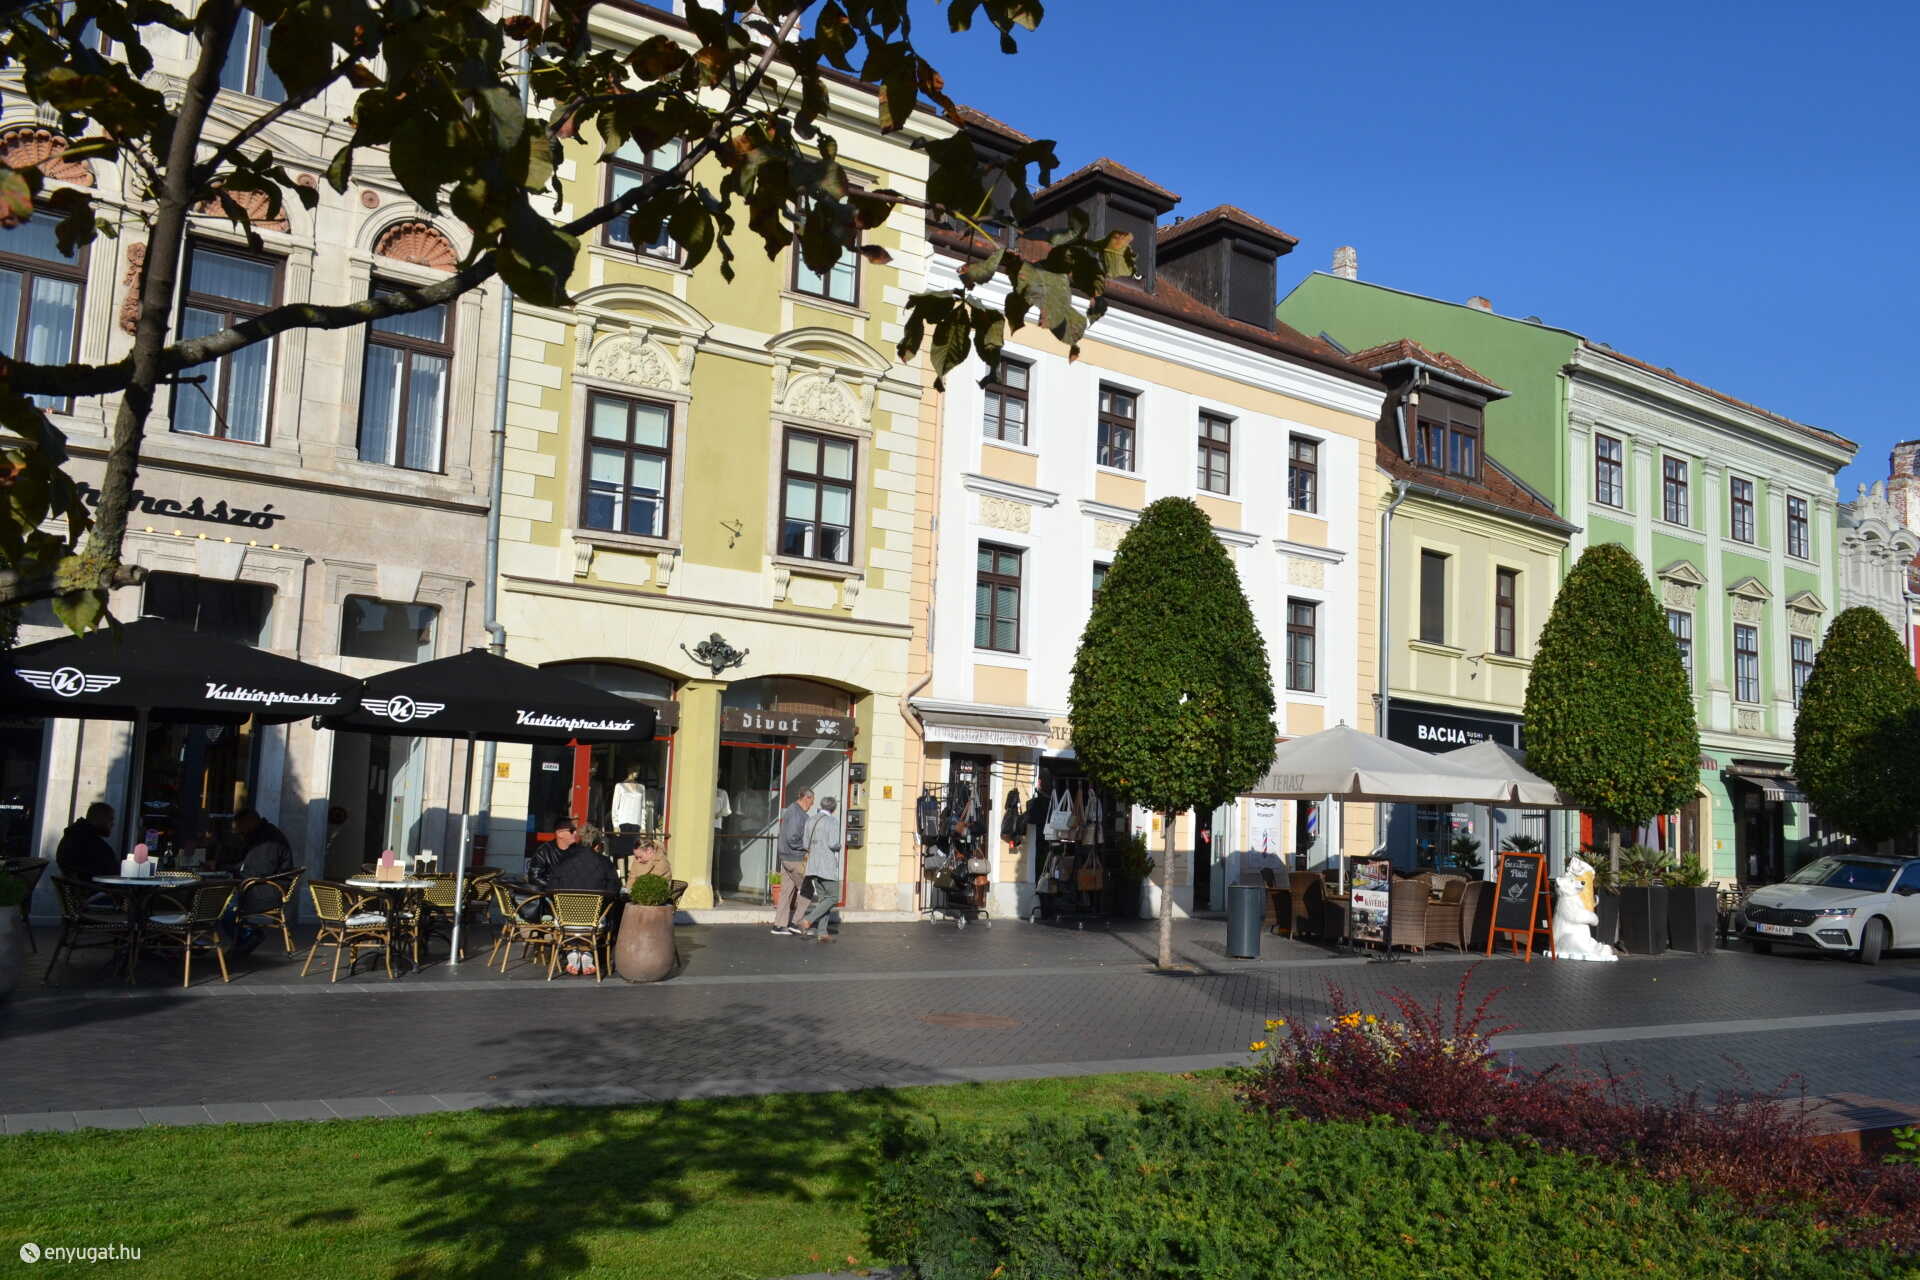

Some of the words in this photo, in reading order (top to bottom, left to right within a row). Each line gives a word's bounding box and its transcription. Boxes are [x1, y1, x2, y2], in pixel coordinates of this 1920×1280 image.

[205, 682, 342, 706] Kultúrpresszó
[516, 709, 635, 732] Kultúrpresszó
[1418, 724, 1466, 744] BACHA
[1272, 774, 1305, 792] TERASZ
